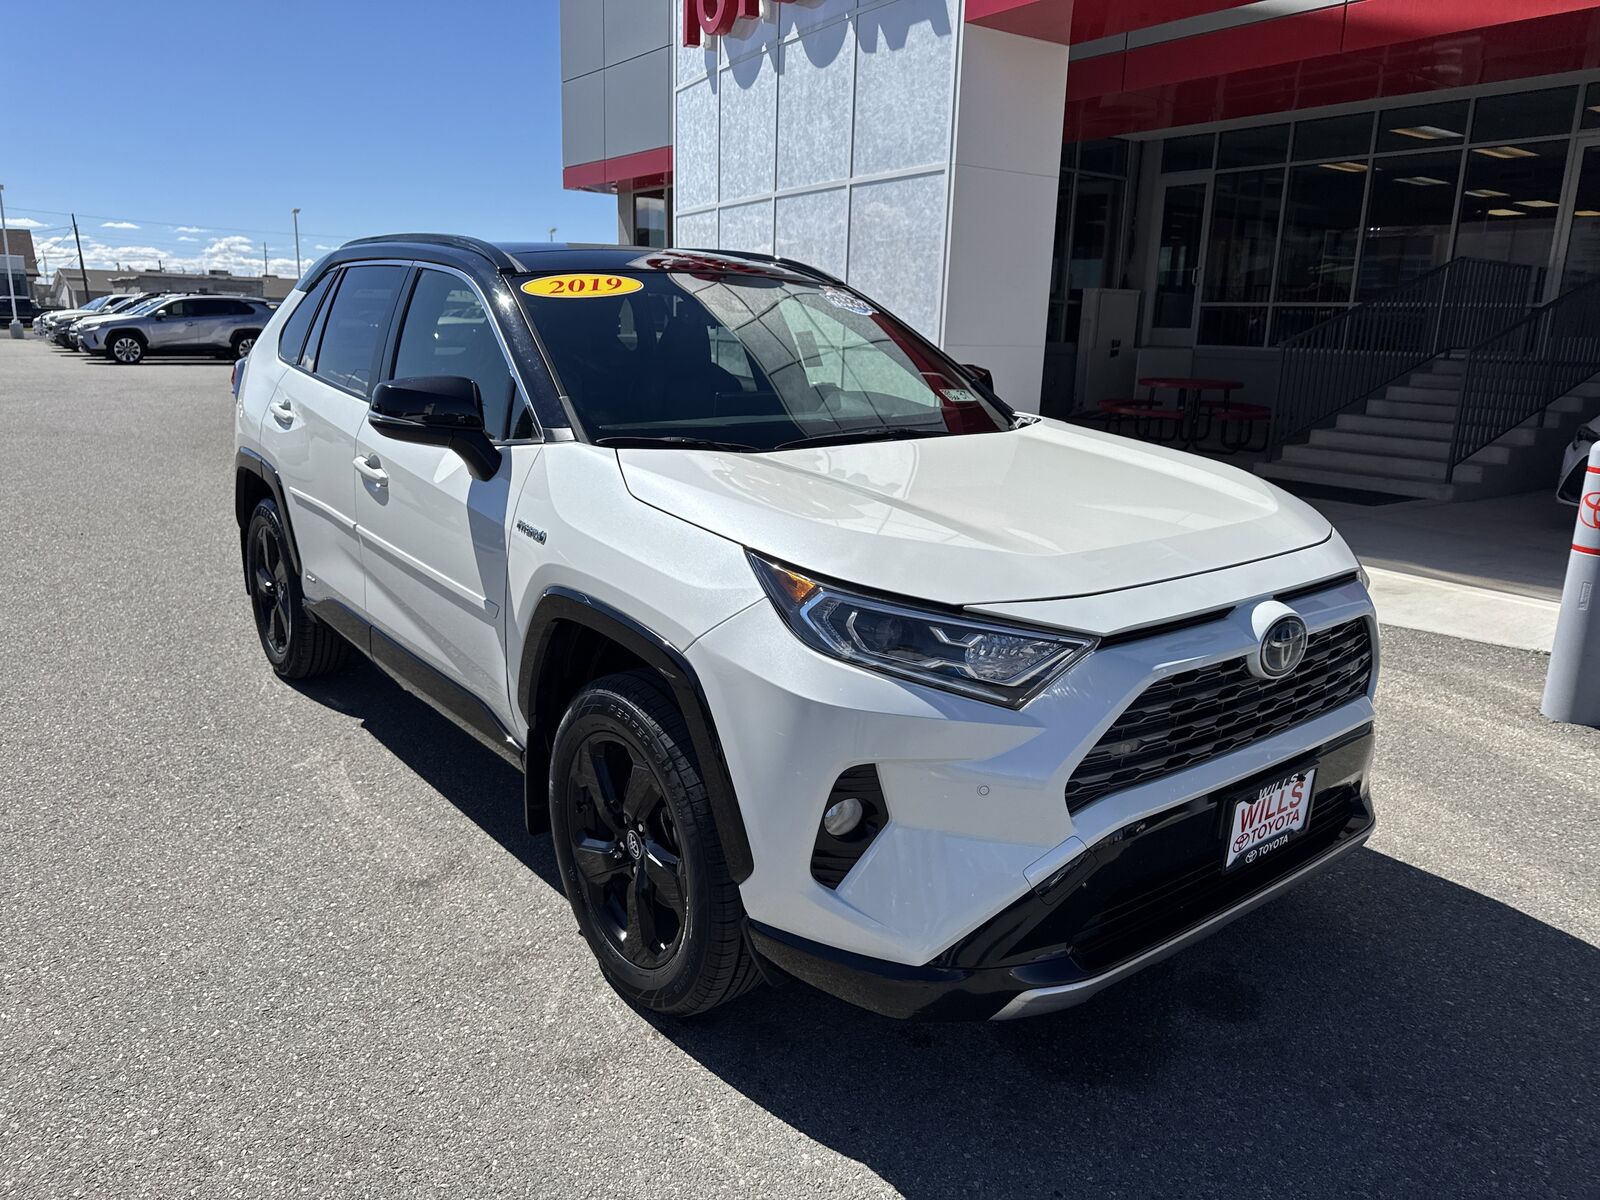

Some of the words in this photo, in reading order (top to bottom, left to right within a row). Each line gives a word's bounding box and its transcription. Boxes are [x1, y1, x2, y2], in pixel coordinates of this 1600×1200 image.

[550, 278, 622, 294] 2019
[1241, 782, 1304, 833] WILLS
[1252, 809, 1300, 843] TOYOTA
[1259, 835, 1289, 857] TOYOTA
